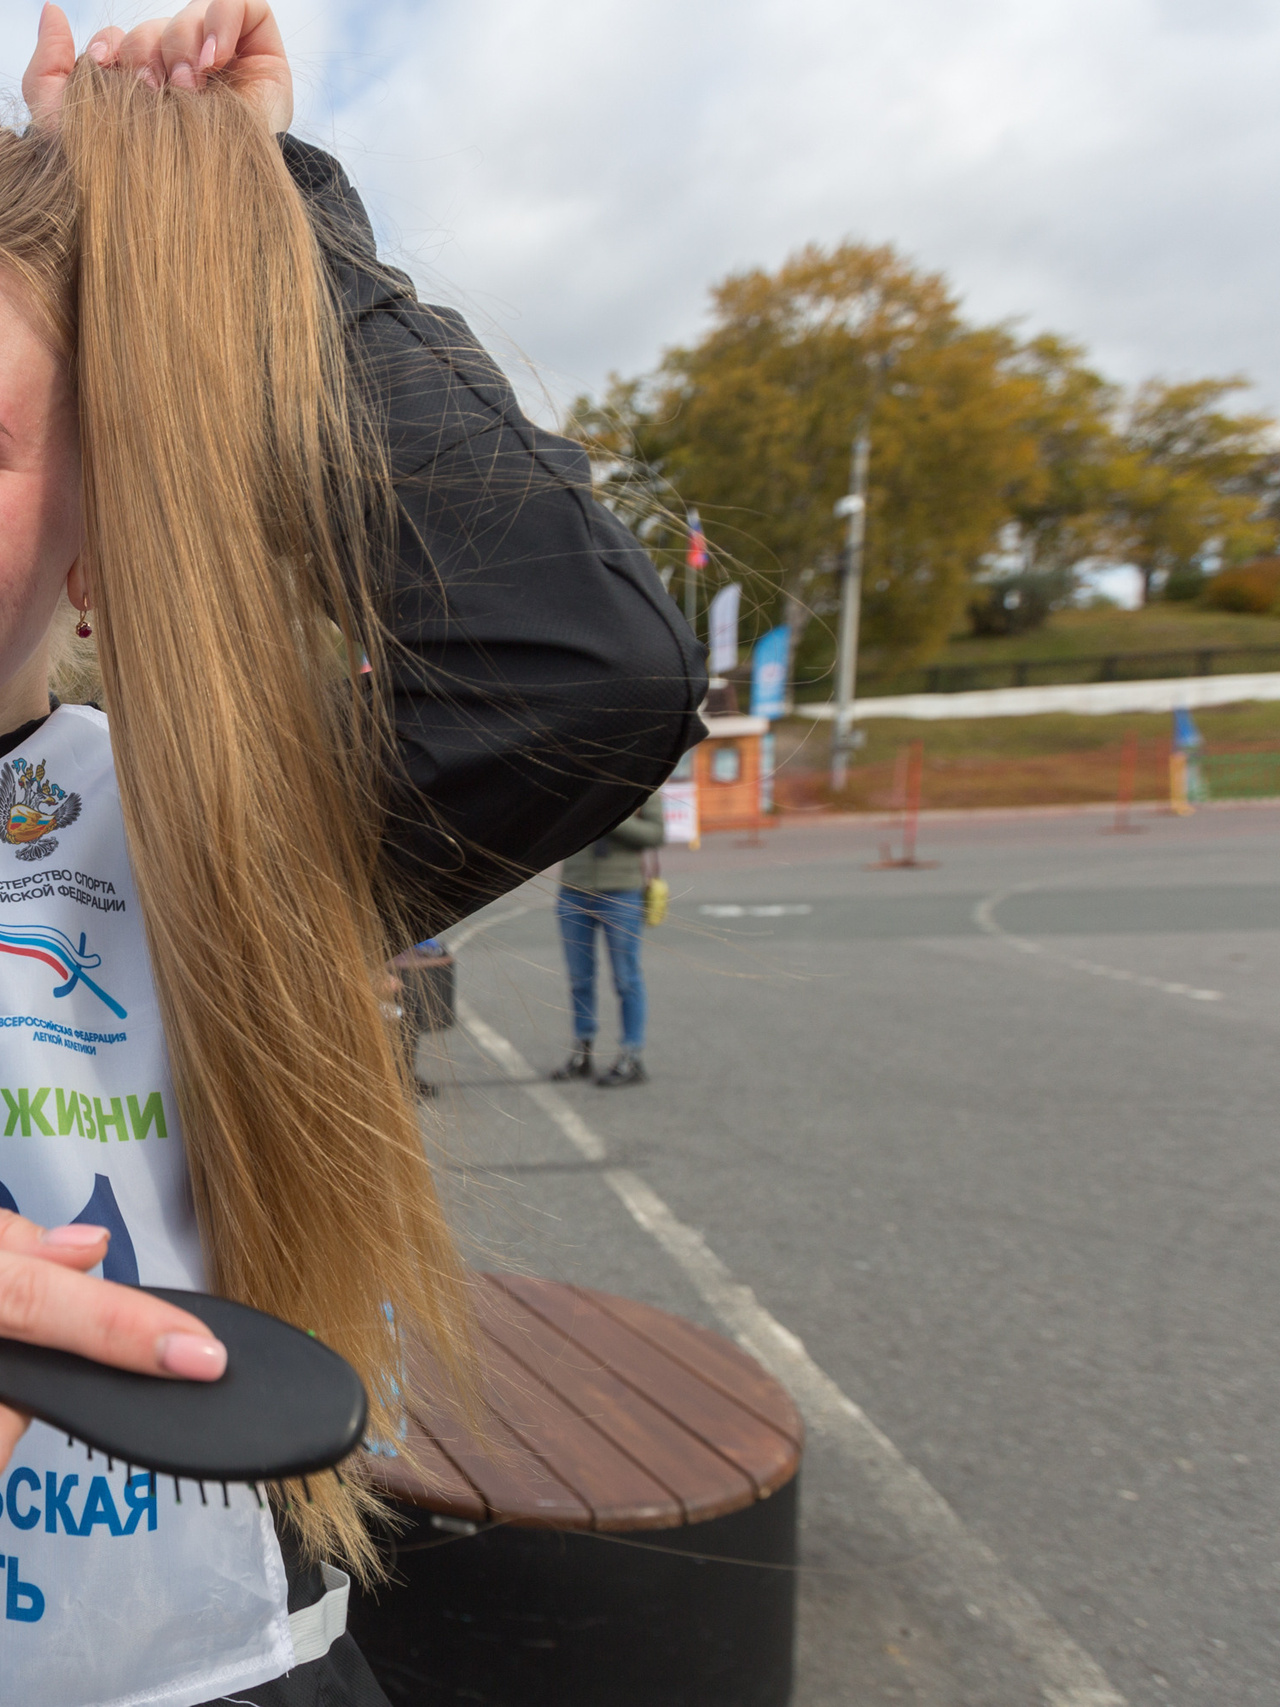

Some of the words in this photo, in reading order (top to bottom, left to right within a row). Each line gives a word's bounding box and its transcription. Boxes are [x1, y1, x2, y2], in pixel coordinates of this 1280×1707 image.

[74, 872, 116, 895] СПОРТА
[57, 885, 126, 912] ФЕДЕРАЦИИ
[74, 1030, 127, 1045] ФЕДЕРАЦИЯ
